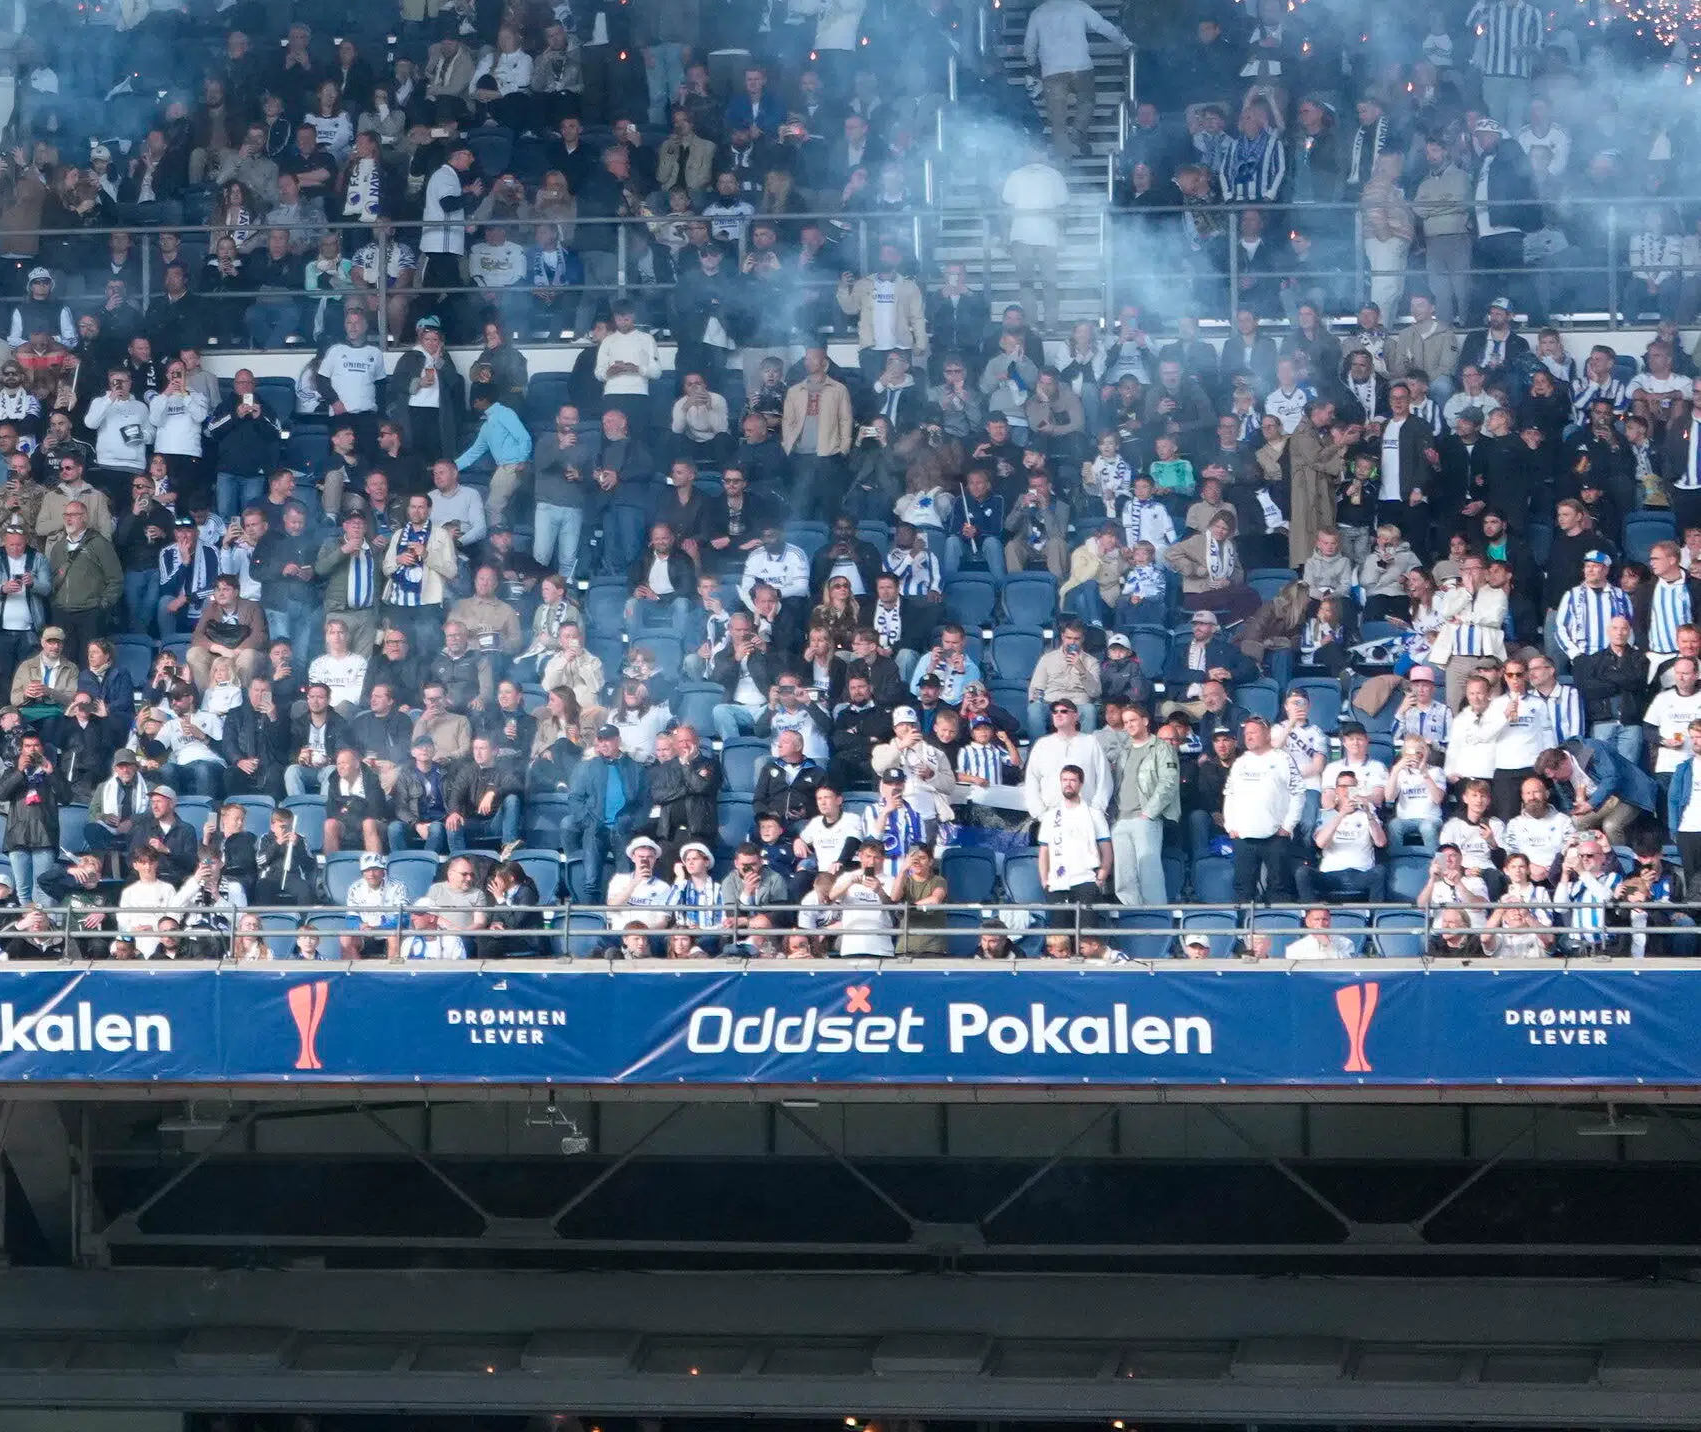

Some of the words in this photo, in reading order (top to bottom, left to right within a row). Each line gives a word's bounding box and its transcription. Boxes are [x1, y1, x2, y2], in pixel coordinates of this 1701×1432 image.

[342, 361, 371, 369] UNIBET
[448, 1009, 566, 1025] DRØMMEN
[1506, 1008, 1631, 1025] DRØMMEN
[471, 1029, 544, 1043] LEVER
[688, 1006, 925, 1054] Oddset
[949, 1002, 1213, 1055] Pokalen
[1530, 1029, 1607, 1044] LEVER
